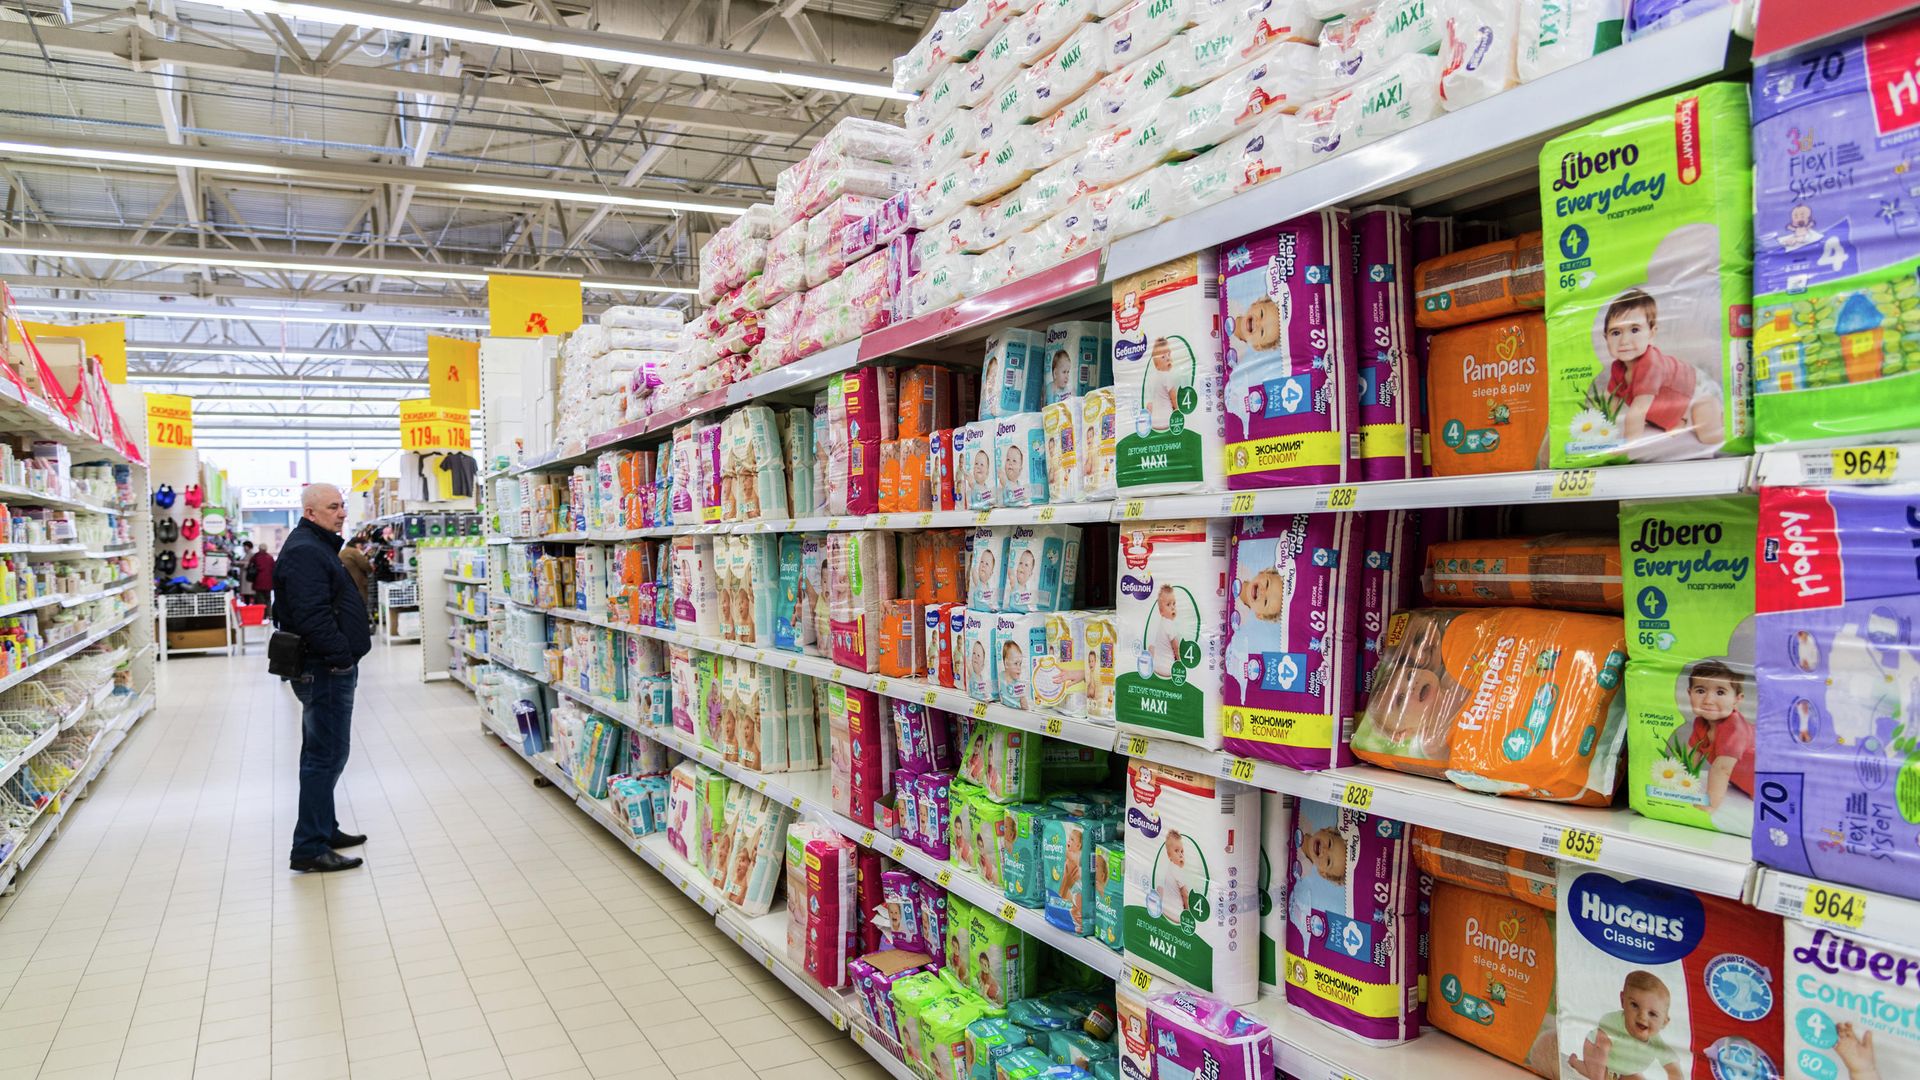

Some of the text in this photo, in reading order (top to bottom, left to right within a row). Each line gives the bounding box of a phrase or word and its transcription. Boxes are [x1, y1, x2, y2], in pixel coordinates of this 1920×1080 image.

[1385, 2, 1425, 37] MAXI
[1061, 45, 1081, 72] MAXI
[1144, 60, 1166, 88] MAXI
[1802, 51, 1845, 90] 70
[1362, 82, 1403, 118] MAXI
[1553, 144, 1639, 192] Libero
[1556, 172, 1666, 218] Everyday
[1607, 204, 1654, 220] ПОДГУЗНИКИ
[1566, 229, 1582, 254] 4
[1276, 233, 1288, 282] Harper
[1286, 234, 1296, 276] Helen
[1817, 236, 1848, 272] 4
[1270, 263, 1280, 296] Baby
[1560, 274, 1576, 288] 66
[1311, 329, 1326, 350] 62
[1374, 326, 1390, 347] 62
[1116, 344, 1146, 358] Бебилон
[1463, 354, 1537, 384] Pampers
[1286, 390, 1300, 404] 4
[1384, 381, 1392, 408] Harper
[1472, 382, 1532, 398] sleep & play
[1182, 392, 1192, 410] 4
[1314, 390, 1322, 412] Helen
[157, 422, 183, 446] 220
[410, 426, 432, 446] 179
[448, 428, 464, 447] 179
[965, 428, 984, 442] Libero
[996, 422, 1016, 436] Libero
[1448, 422, 1459, 440] 4
[1128, 442, 1182, 456] ДЕТСКИЕ ПОДГУЗНИКИ
[1258, 452, 1298, 466] ECONOMY
[1141, 454, 1168, 470] MAXI
[1844, 450, 1886, 476] 964
[1559, 470, 1588, 491] 855
[1234, 496, 1251, 511] 773
[1331, 489, 1351, 506] 828
[1127, 502, 1140, 516] 760
[975, 526, 992, 538] Libero
[1013, 526, 1034, 540] Libero
[1287, 513, 1301, 560] Harper
[1296, 513, 1308, 554] Helen
[1630, 518, 1722, 554] Libero
[1278, 537, 1290, 570] Baby
[1634, 549, 1750, 584] Everyday
[1122, 582, 1152, 592] Бебилон
[1687, 583, 1736, 591] ПОДГУЗНИКИ
[1644, 590, 1660, 614] 4
[966, 616, 981, 629] Libero
[997, 616, 1014, 630] Libero
[1311, 610, 1326, 632] 62
[1365, 612, 1380, 632] 62
[1638, 632, 1654, 645] 66
[1184, 645, 1195, 663] 4
[1282, 669, 1296, 680] 4
[1308, 672, 1316, 694] Helen
[1314, 669, 1322, 698] Harper
[1457, 636, 1515, 731] Pampers
[1492, 643, 1529, 721] sleep & play
[1600, 672, 1614, 685] 4
[1128, 686, 1182, 700] ДЕТСКИЕ ПОДГУЗНИКИ
[1141, 698, 1168, 716] MAXI
[1252, 726, 1290, 739] ECONOMY
[1508, 733, 1526, 752] 4
[1131, 738, 1145, 754] 760
[1234, 760, 1252, 778] 773
[1347, 785, 1368, 806] 828
[1760, 782, 1788, 823] 70
[1128, 814, 1160, 832] Бебилон
[1043, 839, 1063, 854] Pampers
[1566, 830, 1596, 854] 855
[1374, 882, 1390, 904] 62
[1420, 876, 1433, 896] 62
[1193, 900, 1204, 916] 4
[1581, 890, 1684, 942] HUGGIES
[1814, 889, 1854, 922] 964
[1136, 919, 1156, 934] ДЕТСКИЕ
[1157, 926, 1192, 951] ПОДГУЗНИКИ
[1346, 933, 1359, 946] 4
[1465, 916, 1536, 967] Pampers
[1604, 928, 1656, 951] Classic
[1149, 935, 1178, 960] MAXI
[1473, 954, 1531, 983] sleep & play
[1736, 956, 1745, 964] 12
[1794, 929, 1920, 988] Liber
[1134, 968, 1148, 988] 760
[1446, 978, 1456, 996] 4
[1318, 982, 1356, 1005] ECONOMY
[1807, 1013, 1826, 1038] 4
[1800, 1054, 1822, 1071] 80
